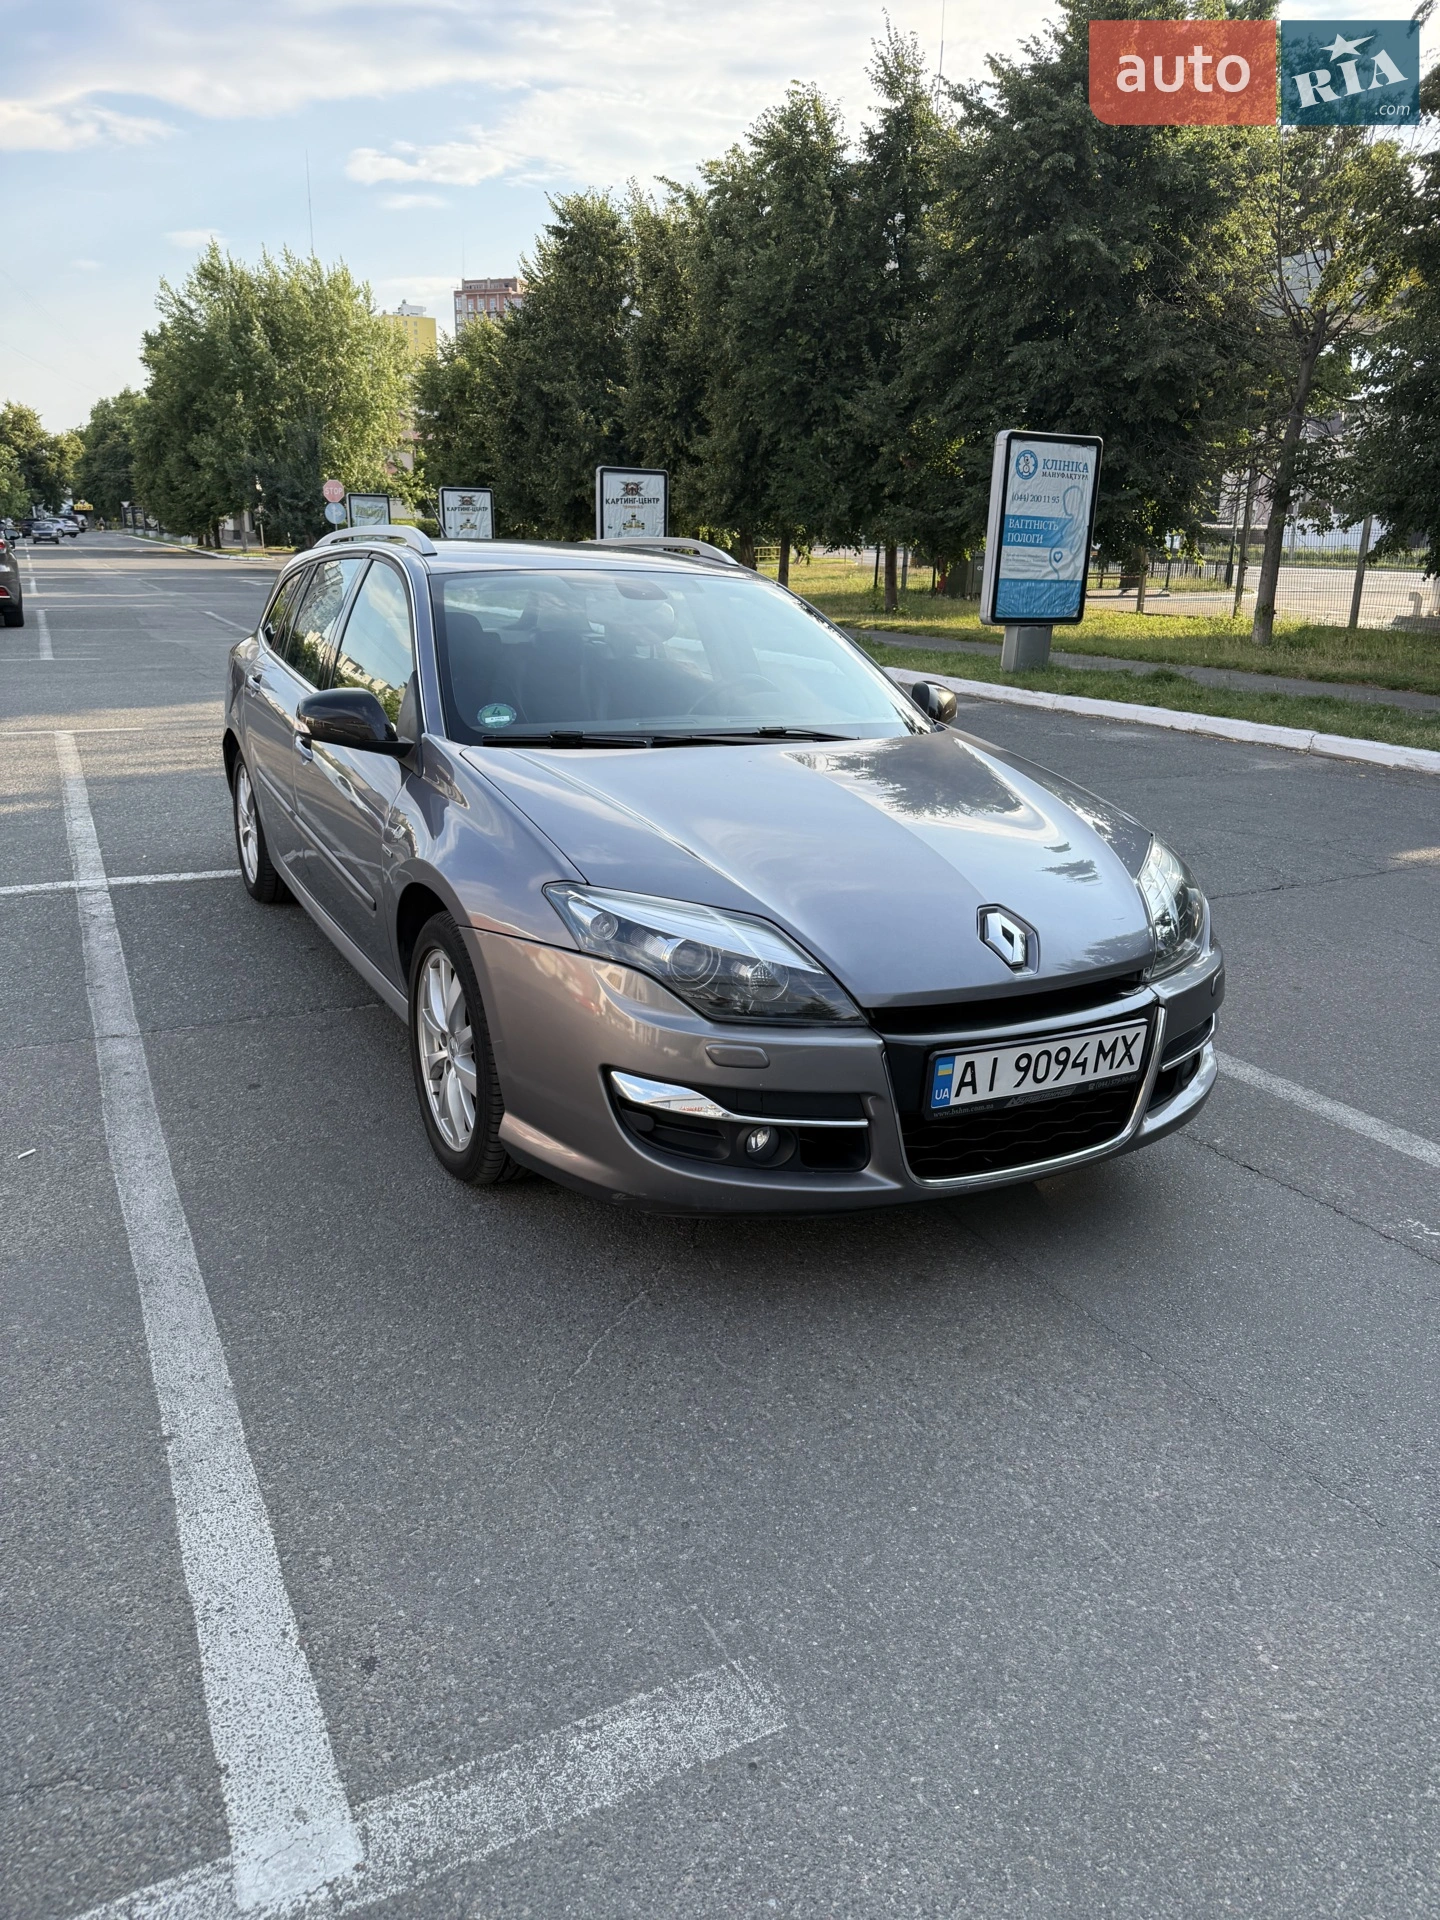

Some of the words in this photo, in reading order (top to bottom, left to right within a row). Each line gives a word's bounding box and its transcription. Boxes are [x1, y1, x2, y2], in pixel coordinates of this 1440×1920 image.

[1042, 459, 1089, 473] КЛІНІКА
[1041, 471, 1089, 480] МАНУФАКТУРА
[324, 487, 343, 495] STOP
[1011, 491, 1029, 502] (044)
[1029, 493, 1042, 503] 200
[1043, 495, 1050, 503] 11
[605, 497, 660, 506] КАРТИНГ-ЦЕНТР
[1008, 518, 1059, 531] ВАГІТНІСТЬ
[1007, 532, 1044, 544] ПОЛОГИ
[954, 1057, 998, 1098] AI
[1013, 1041, 1090, 1088] 9094
[1093, 1032, 1141, 1073] MX
[935, 1087, 949, 1100] UA
